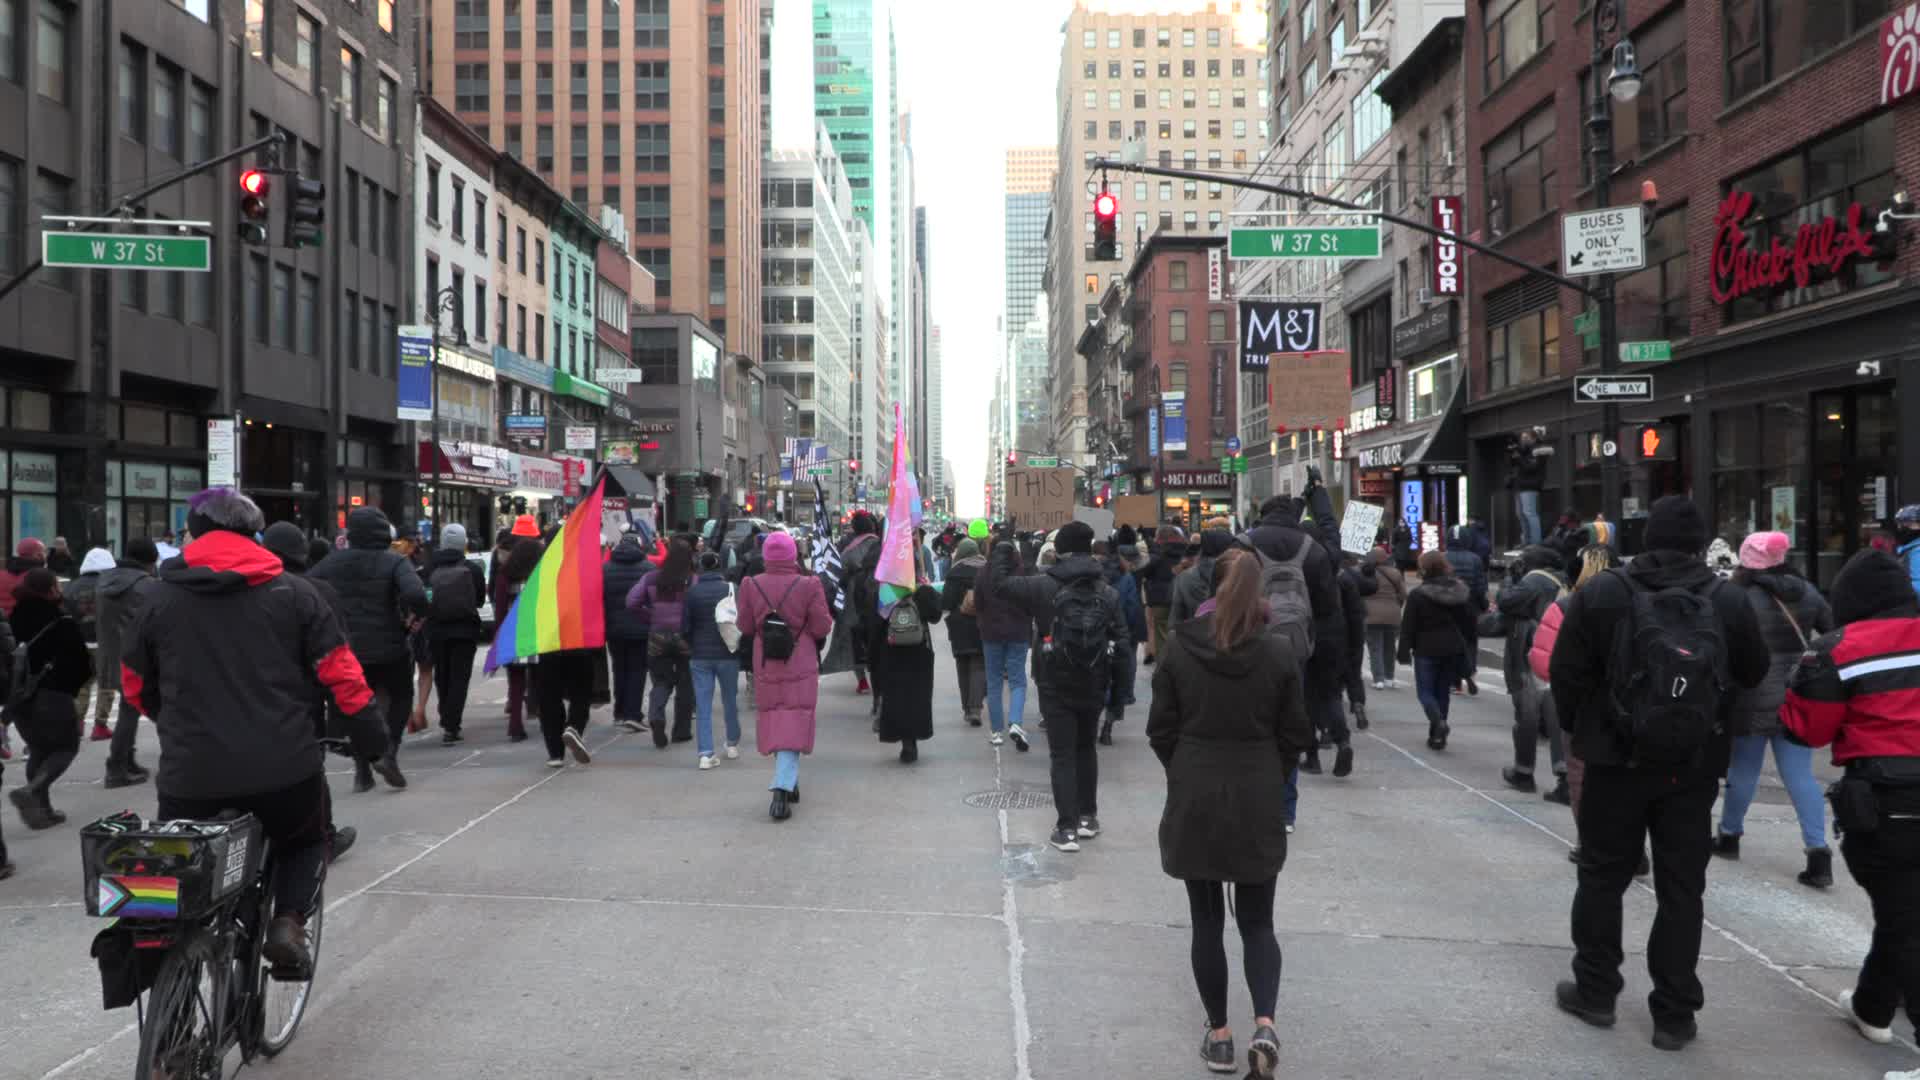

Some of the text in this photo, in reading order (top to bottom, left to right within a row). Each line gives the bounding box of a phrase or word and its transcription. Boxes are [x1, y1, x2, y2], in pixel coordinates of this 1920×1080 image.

[1580, 212, 1624, 229] BUSES
[91, 240, 165, 262] W 37 St
[1271, 233, 1339, 252] W 37 St
[1585, 234, 1619, 250] ONLY
[1246, 308, 1314, 350] M&J
[1587, 384, 1641, 393] ONE WAY
[1008, 471, 1064, 497] THIS
[1168, 473, 1185, 485] PRET
